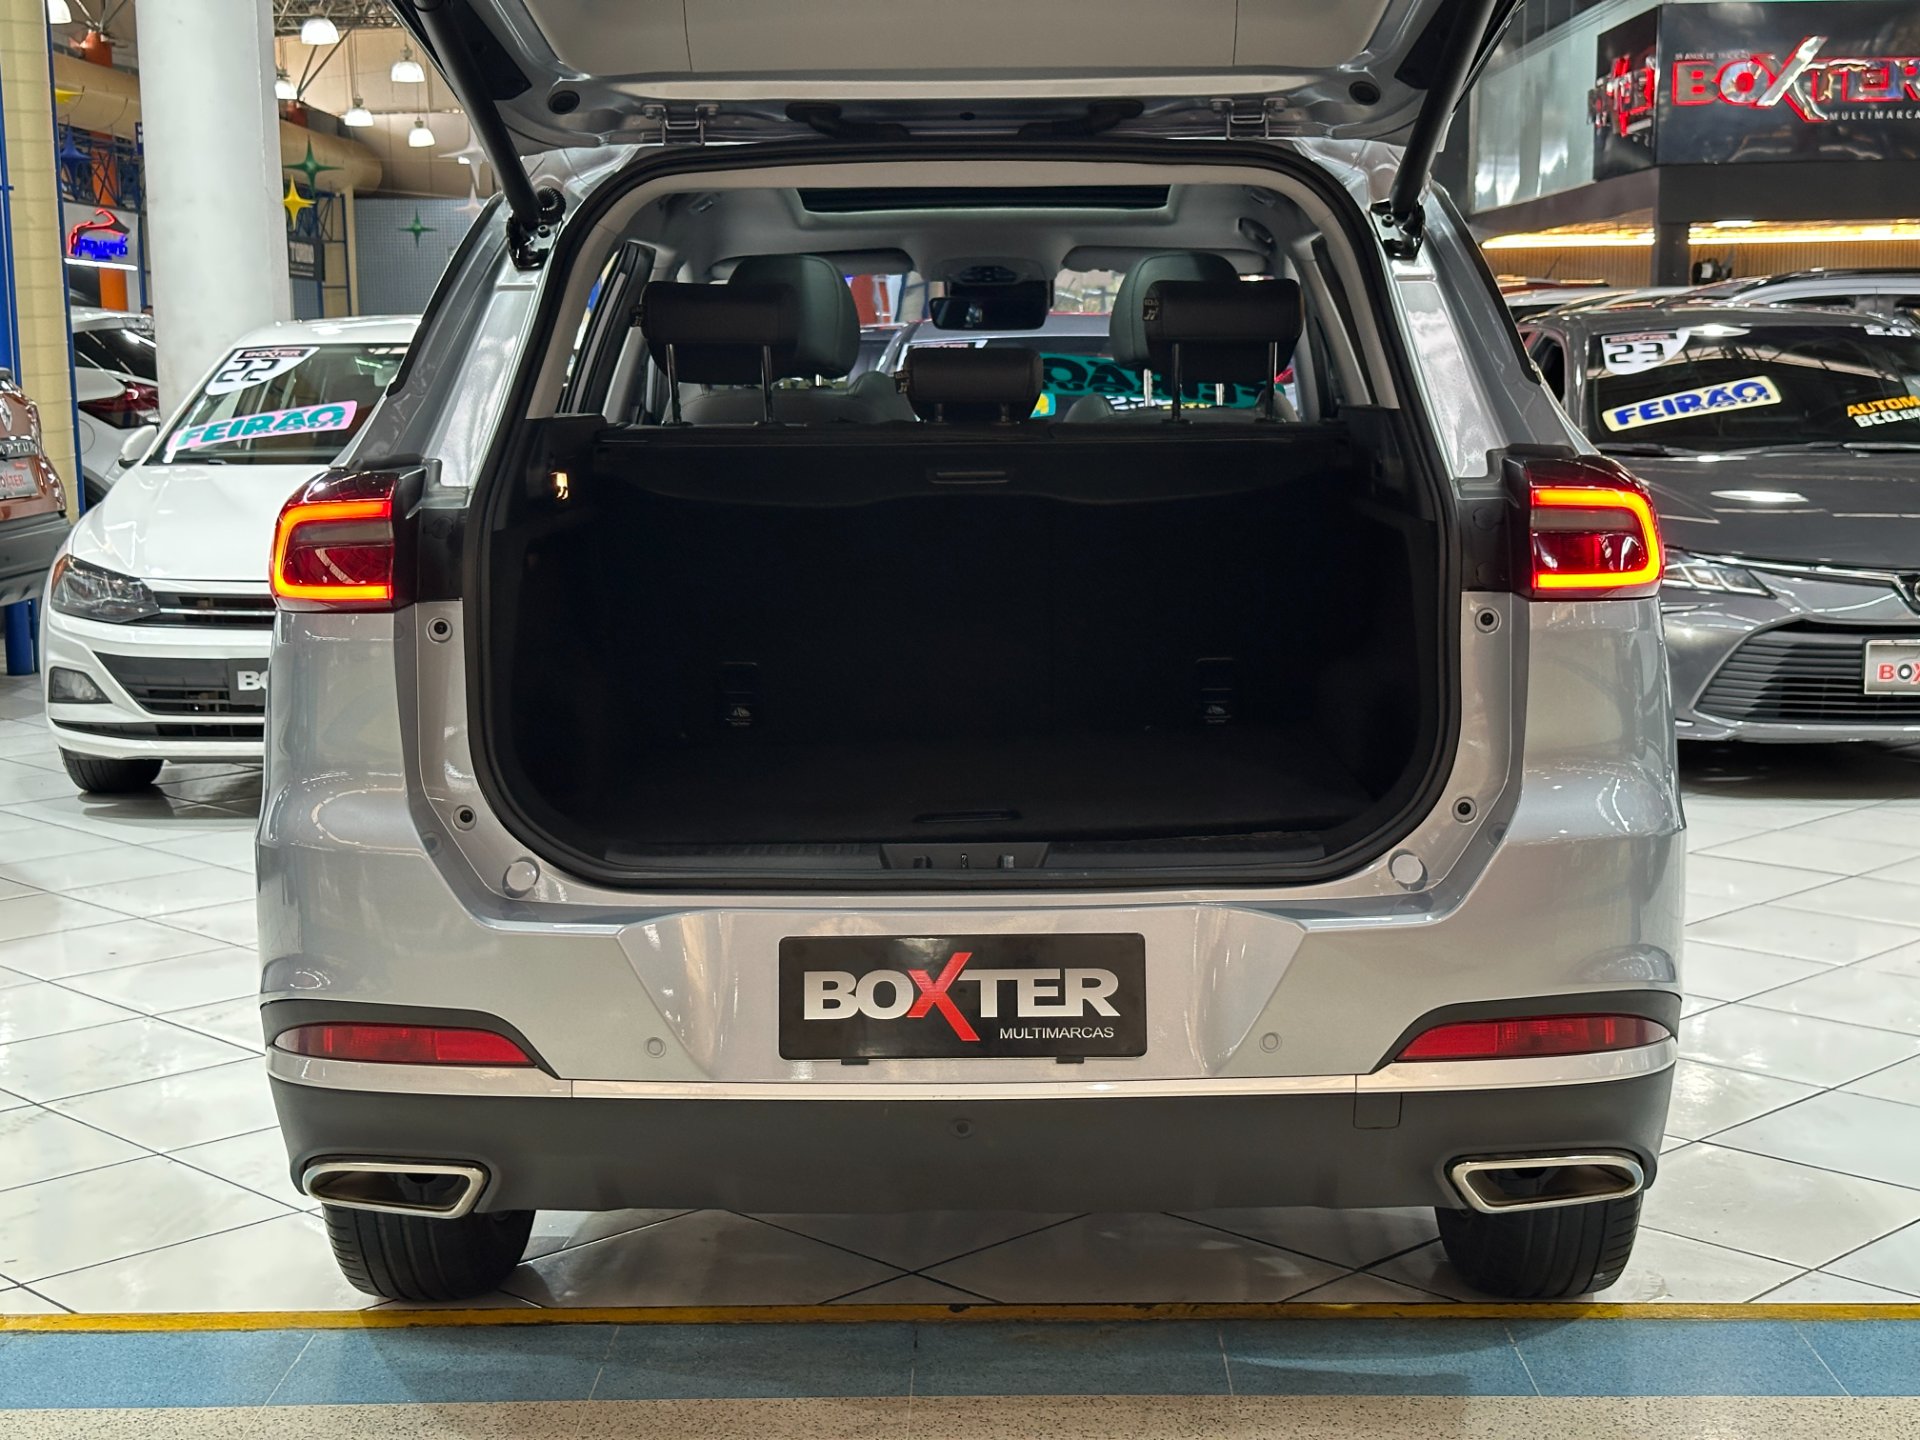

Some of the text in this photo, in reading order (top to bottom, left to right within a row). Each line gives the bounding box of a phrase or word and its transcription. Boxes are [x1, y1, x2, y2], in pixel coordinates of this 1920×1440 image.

[1609, 342, 1665, 364] 23
[215, 359, 281, 383] 22
[1614, 382, 1768, 426] FEIRÃO
[176, 406, 346, 447] FEIRÃO
[803, 952, 1121, 1041] BOXTER
[999, 1026, 1115, 1040] MULTIMARCAS
